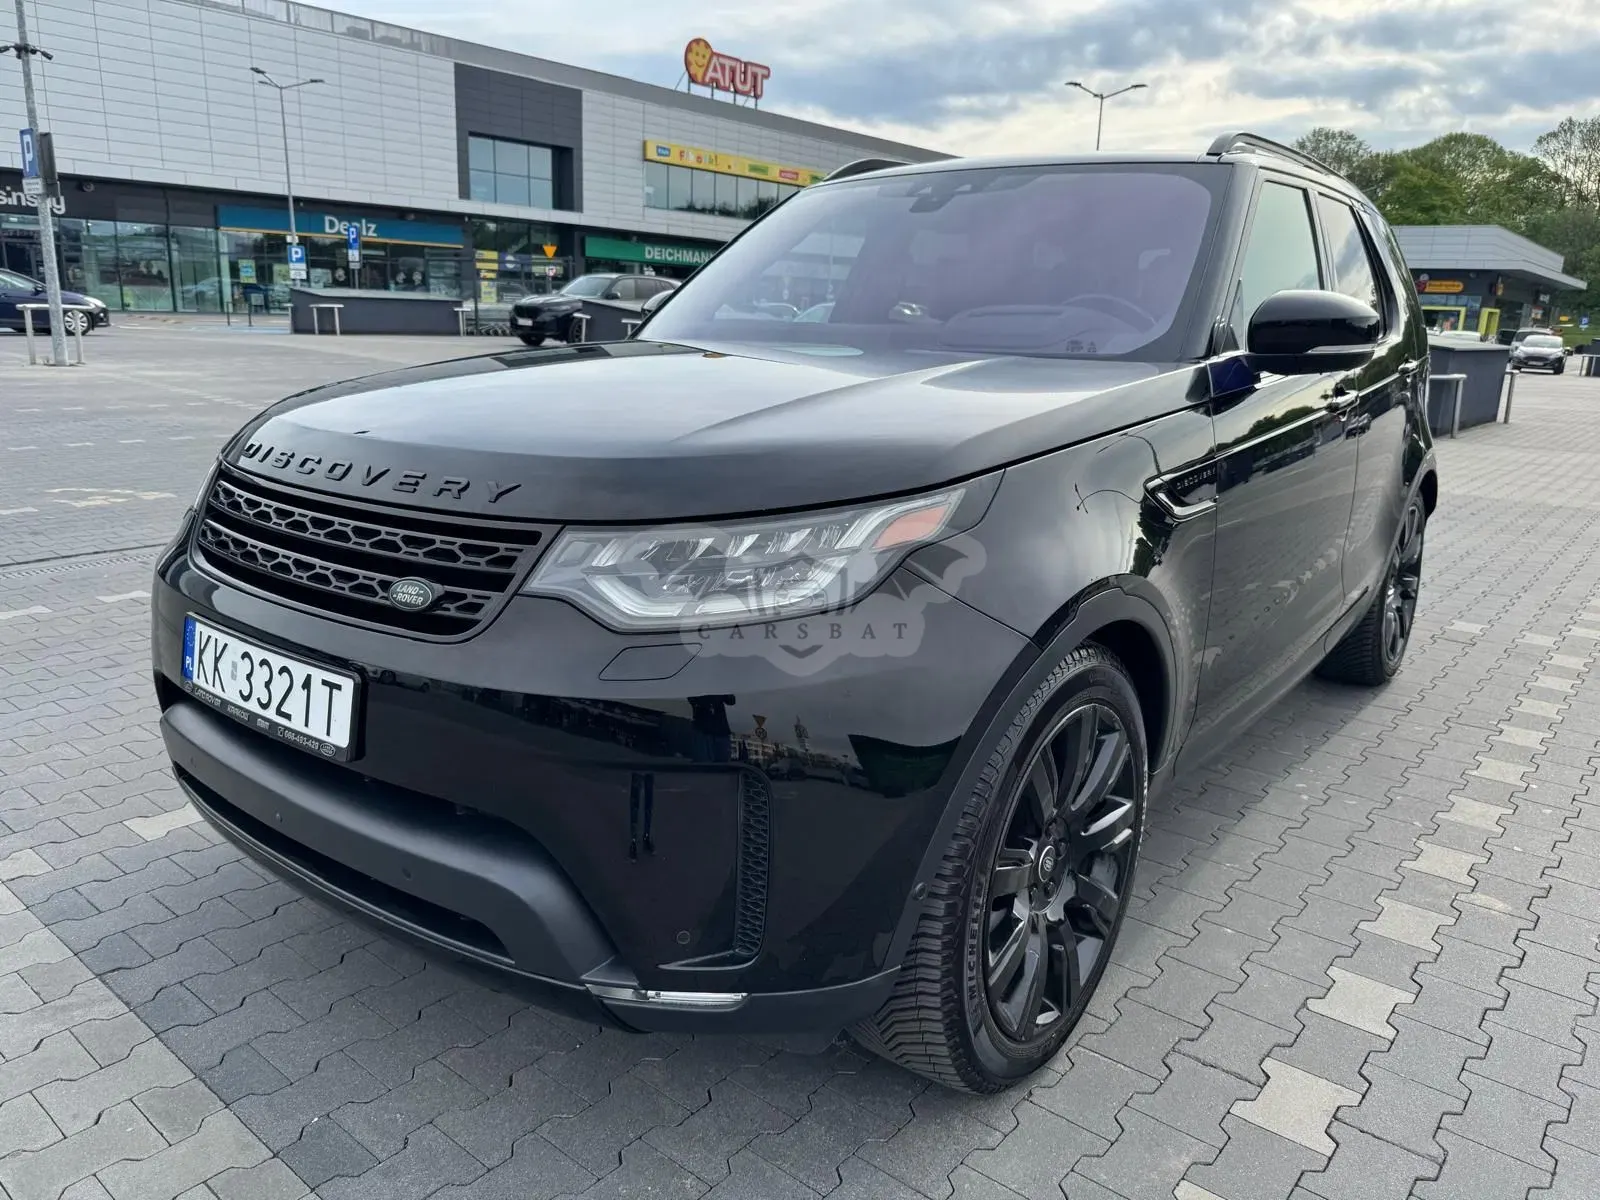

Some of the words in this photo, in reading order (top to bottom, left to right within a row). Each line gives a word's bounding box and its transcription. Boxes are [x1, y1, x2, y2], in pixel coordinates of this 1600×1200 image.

[705, 56, 769, 98] ATUT
[23, 135, 33, 172] P
[0, 186, 66, 215] sinsy
[349, 227, 357, 242] P
[291, 247, 302, 261] P
[240, 442, 522, 504] DISCOVERY
[1177, 468, 1216, 490] DISCOVERY
[185, 655, 194, 671] PL
[197, 630, 229, 694] KK
[238, 651, 343, 737] 3321T
